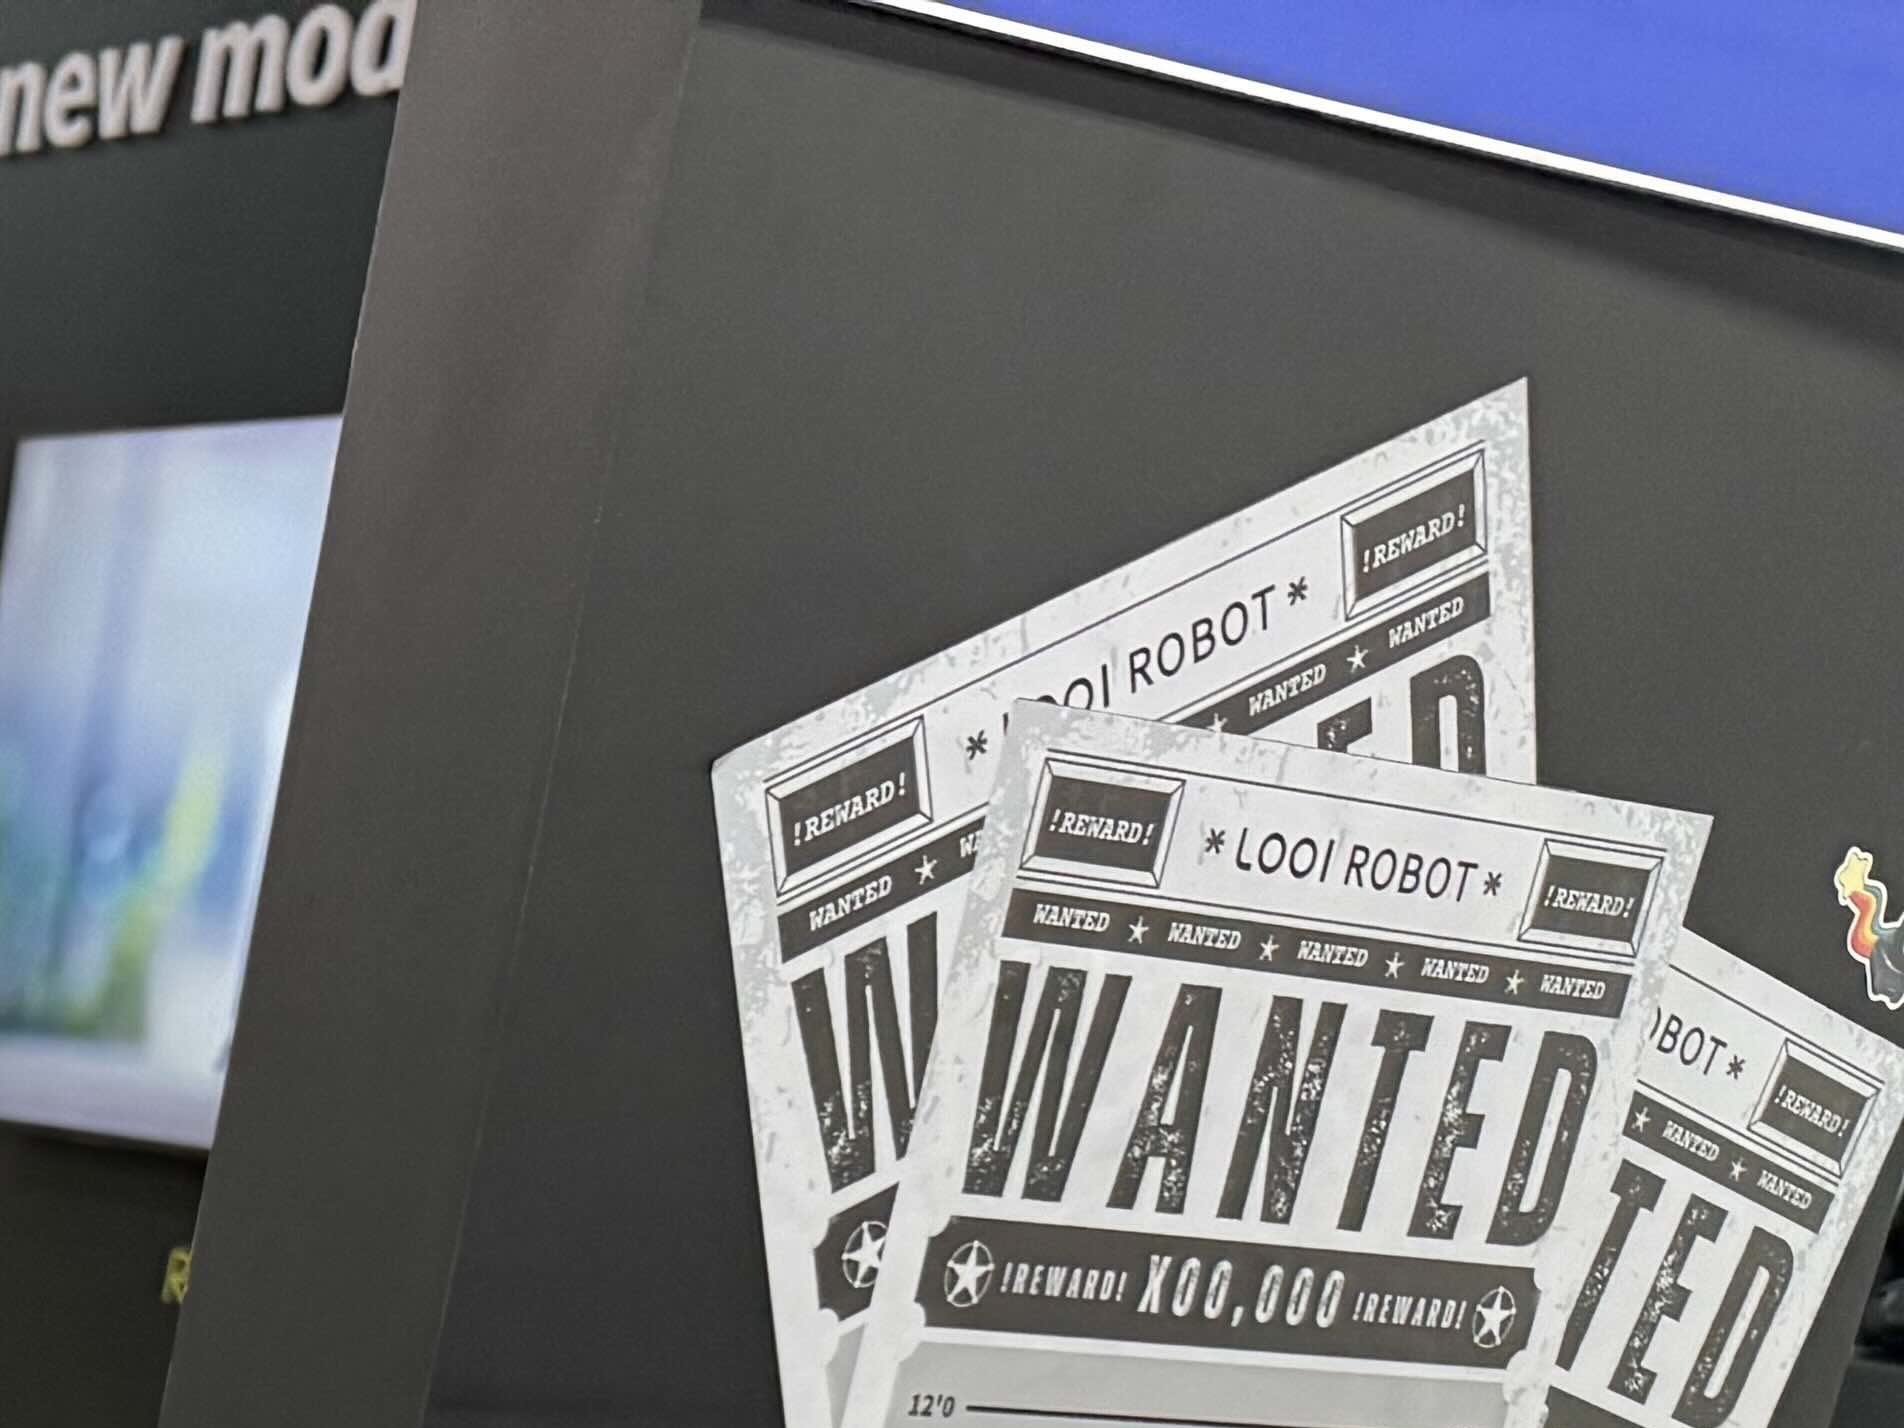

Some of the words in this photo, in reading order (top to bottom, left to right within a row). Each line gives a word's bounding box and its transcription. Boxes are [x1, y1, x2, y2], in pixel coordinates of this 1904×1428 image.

[1362, 504, 1465, 572] !REWARD!
[1129, 584, 1276, 694] ROBOT
[809, 876, 892, 931] WANTED
[1249, 663, 1327, 717] WANTED
[1388, 596, 1464, 648] WANTED
[794, 772, 906, 847] !REWARD!
[1049, 808, 1153, 846] !REWARD!
[1236, 827, 1335, 882] LOOI
[1345, 843, 1479, 902] ROBOT
[1543, 885, 1634, 918] !REWARD!
[1033, 904, 1110, 932] WANTED
[1167, 922, 1241, 950] WANTED
[1297, 940, 1369, 967] WANTED
[1421, 957, 1490, 985] WANTED
[1540, 974, 1606, 1000] WANTED
[1651, 1007, 1727, 1076] BOT
[962, 961, 1597, 1246] WANTED
[1774, 1084, 1850, 1138] !REWARD!
[1661, 1119, 1721, 1163] WANTED
[1756, 1169, 1812, 1211] WANTED
[1000, 1262, 1128, 1302] !REWARD!
[1352, 1291, 1467, 1331] !REWARD!
[908, 1394, 955, 1417] 12'0
